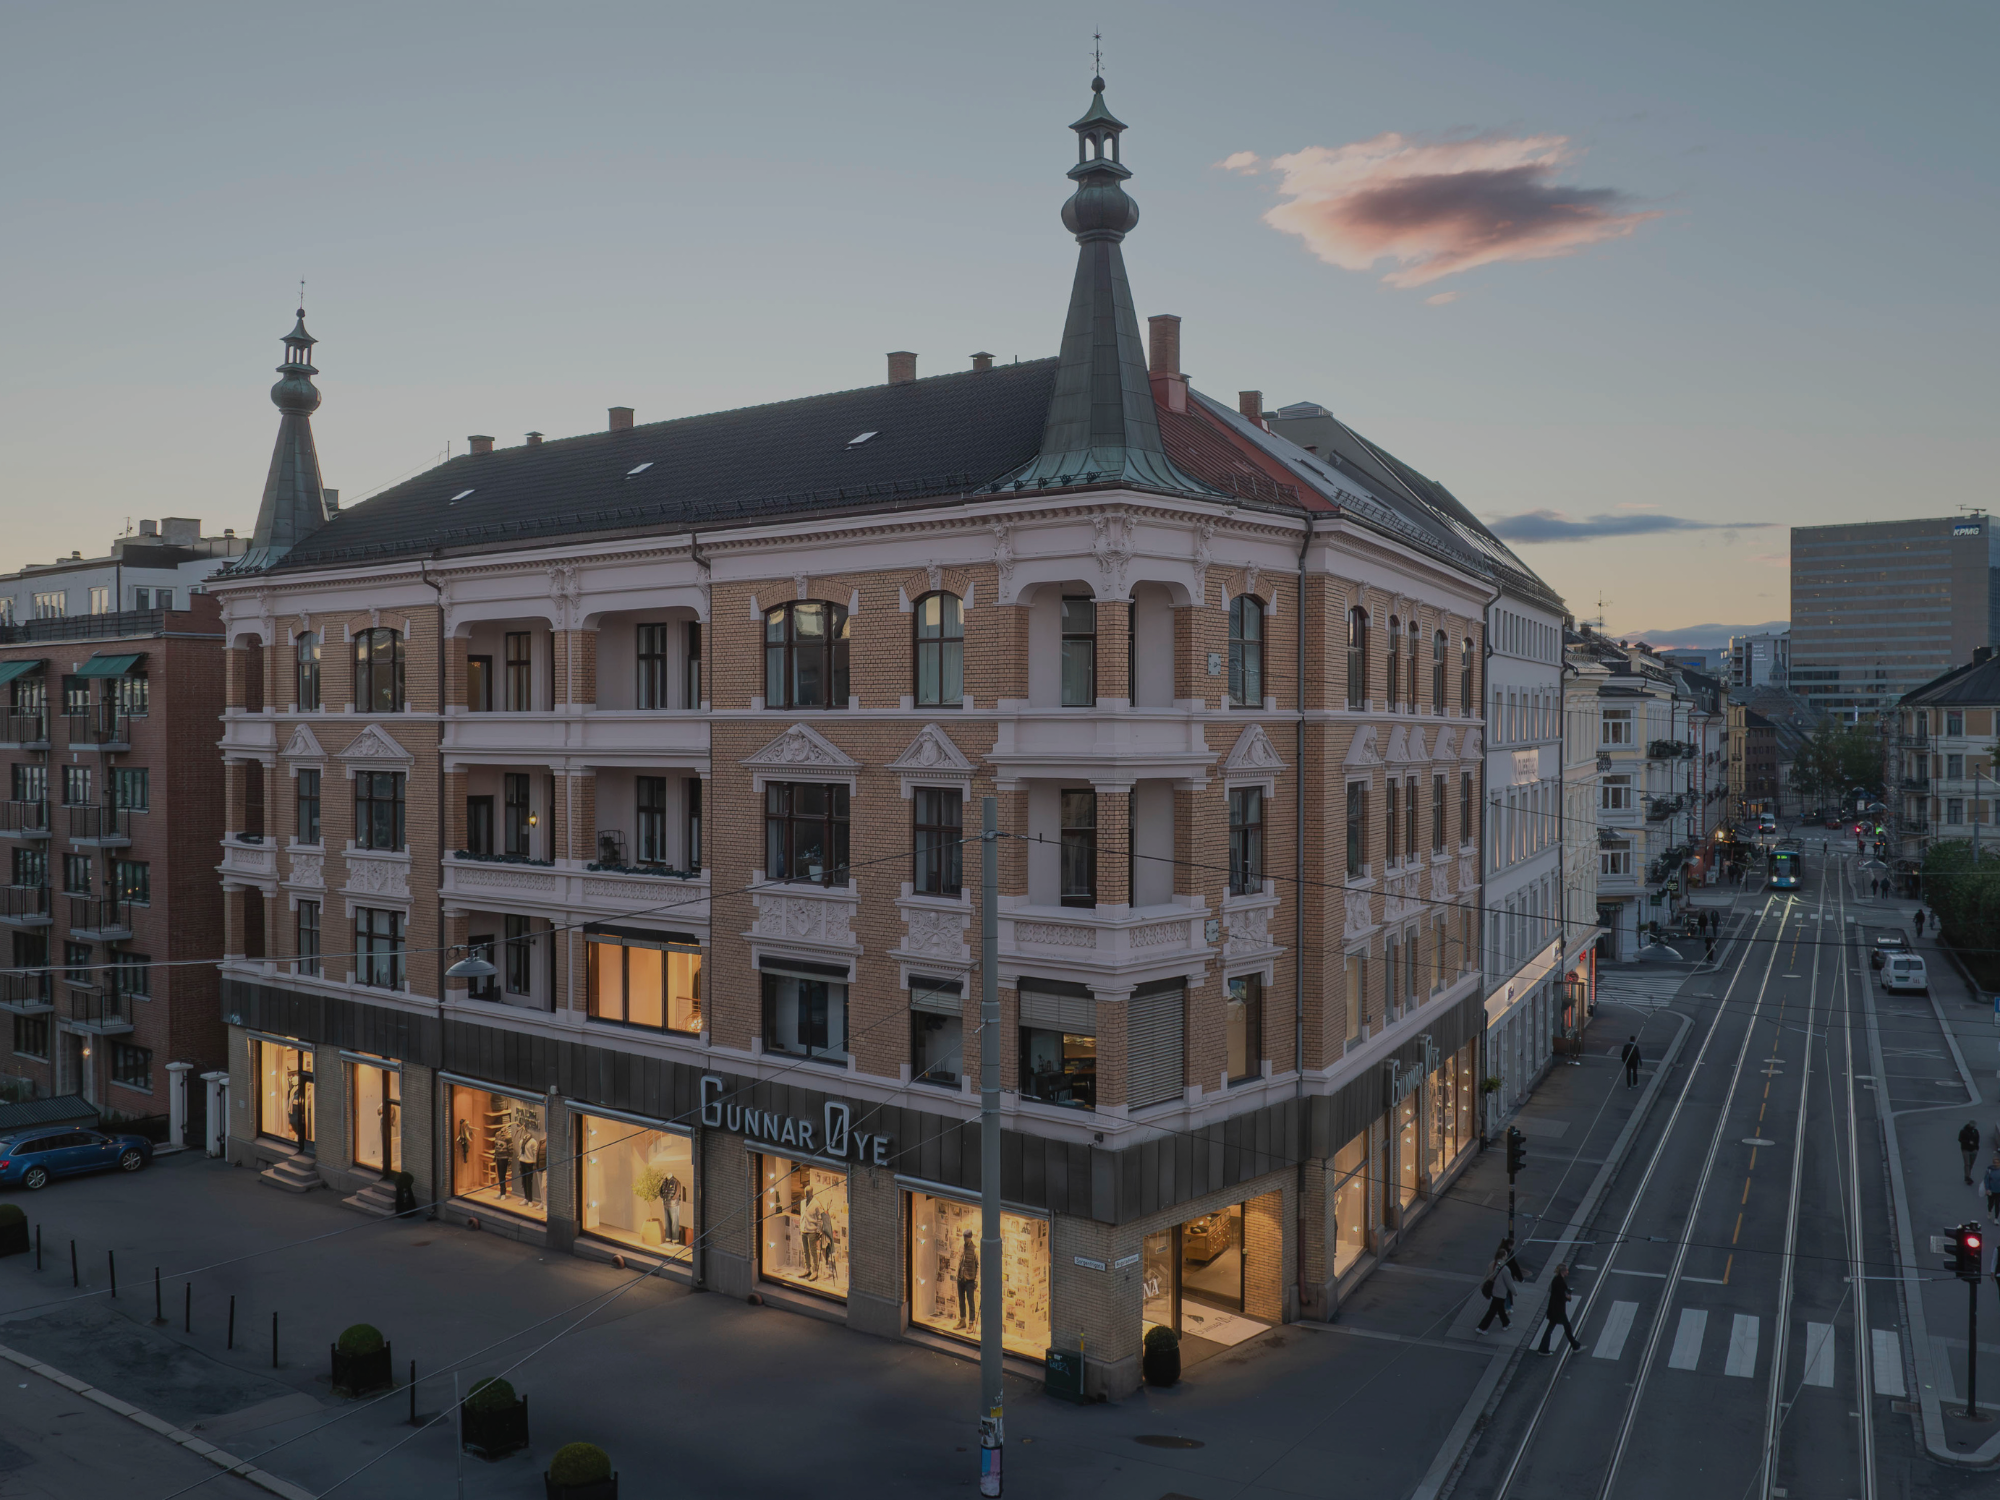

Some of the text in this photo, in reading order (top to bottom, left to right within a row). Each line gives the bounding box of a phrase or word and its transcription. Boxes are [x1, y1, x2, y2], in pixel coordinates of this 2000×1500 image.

[1953, 527, 1980, 536] KPMG
[1392, 1059, 1424, 1107] GUNNAR
[701, 1075, 890, 1167] GUNNAR ØYE
